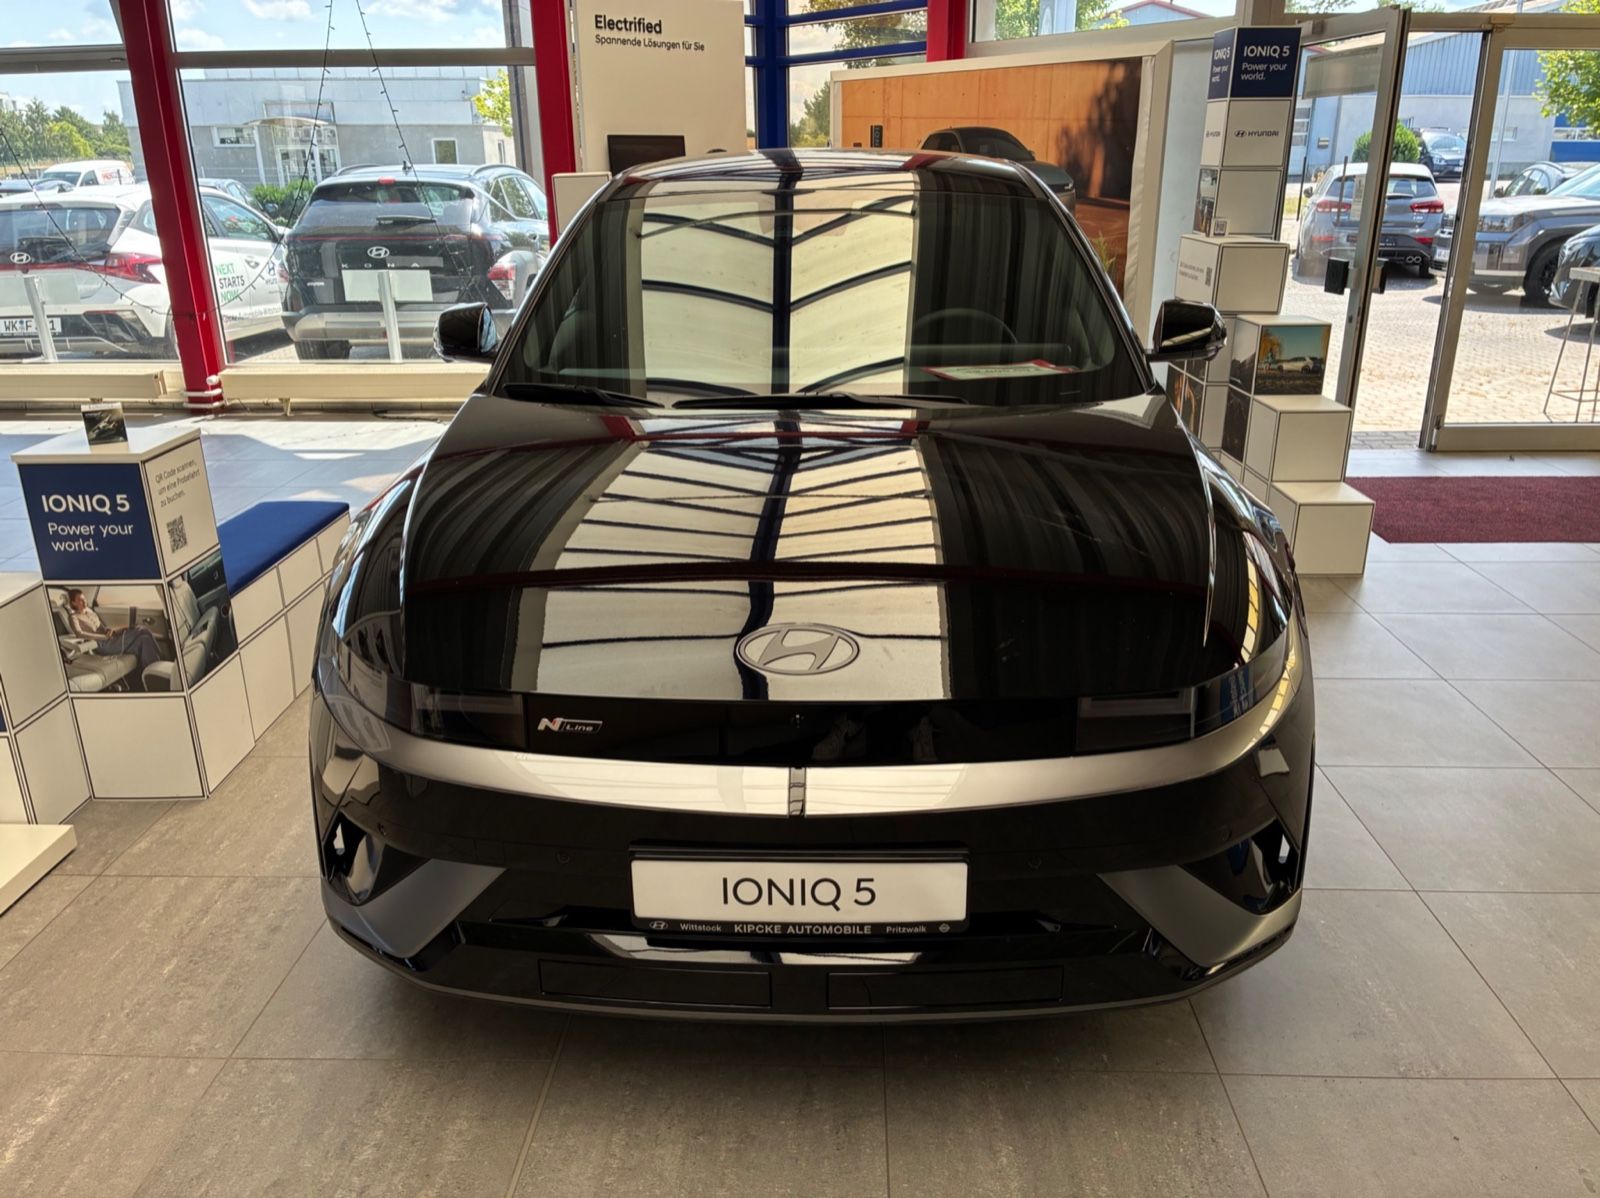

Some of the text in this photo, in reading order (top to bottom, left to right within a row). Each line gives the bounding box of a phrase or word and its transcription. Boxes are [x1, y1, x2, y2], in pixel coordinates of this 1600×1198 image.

[594, 14, 663, 34] Electrified
[595, 34, 705, 51] Spannende Lösungen für Sie
[1214, 46, 1231, 60] IONIQ 5
[1243, 45, 1291, 58] IONIQ 5
[1242, 62, 1288, 72] Power your
[1240, 72, 1266, 80] world.
[215, 263, 235, 275] NEXT
[218, 275, 245, 289] STARTS
[164, 468, 176, 480] Code
[41, 494, 130, 515] IONIQ 5
[47, 522, 134, 538] Power your
[51, 538, 99, 552] world.
[537, 717, 593, 732] N Line
[722, 877, 876, 912] IONIQ 5
[679, 922, 927, 935] Wittstock KIPCKE AUTOMOBILE Pritzwalk
